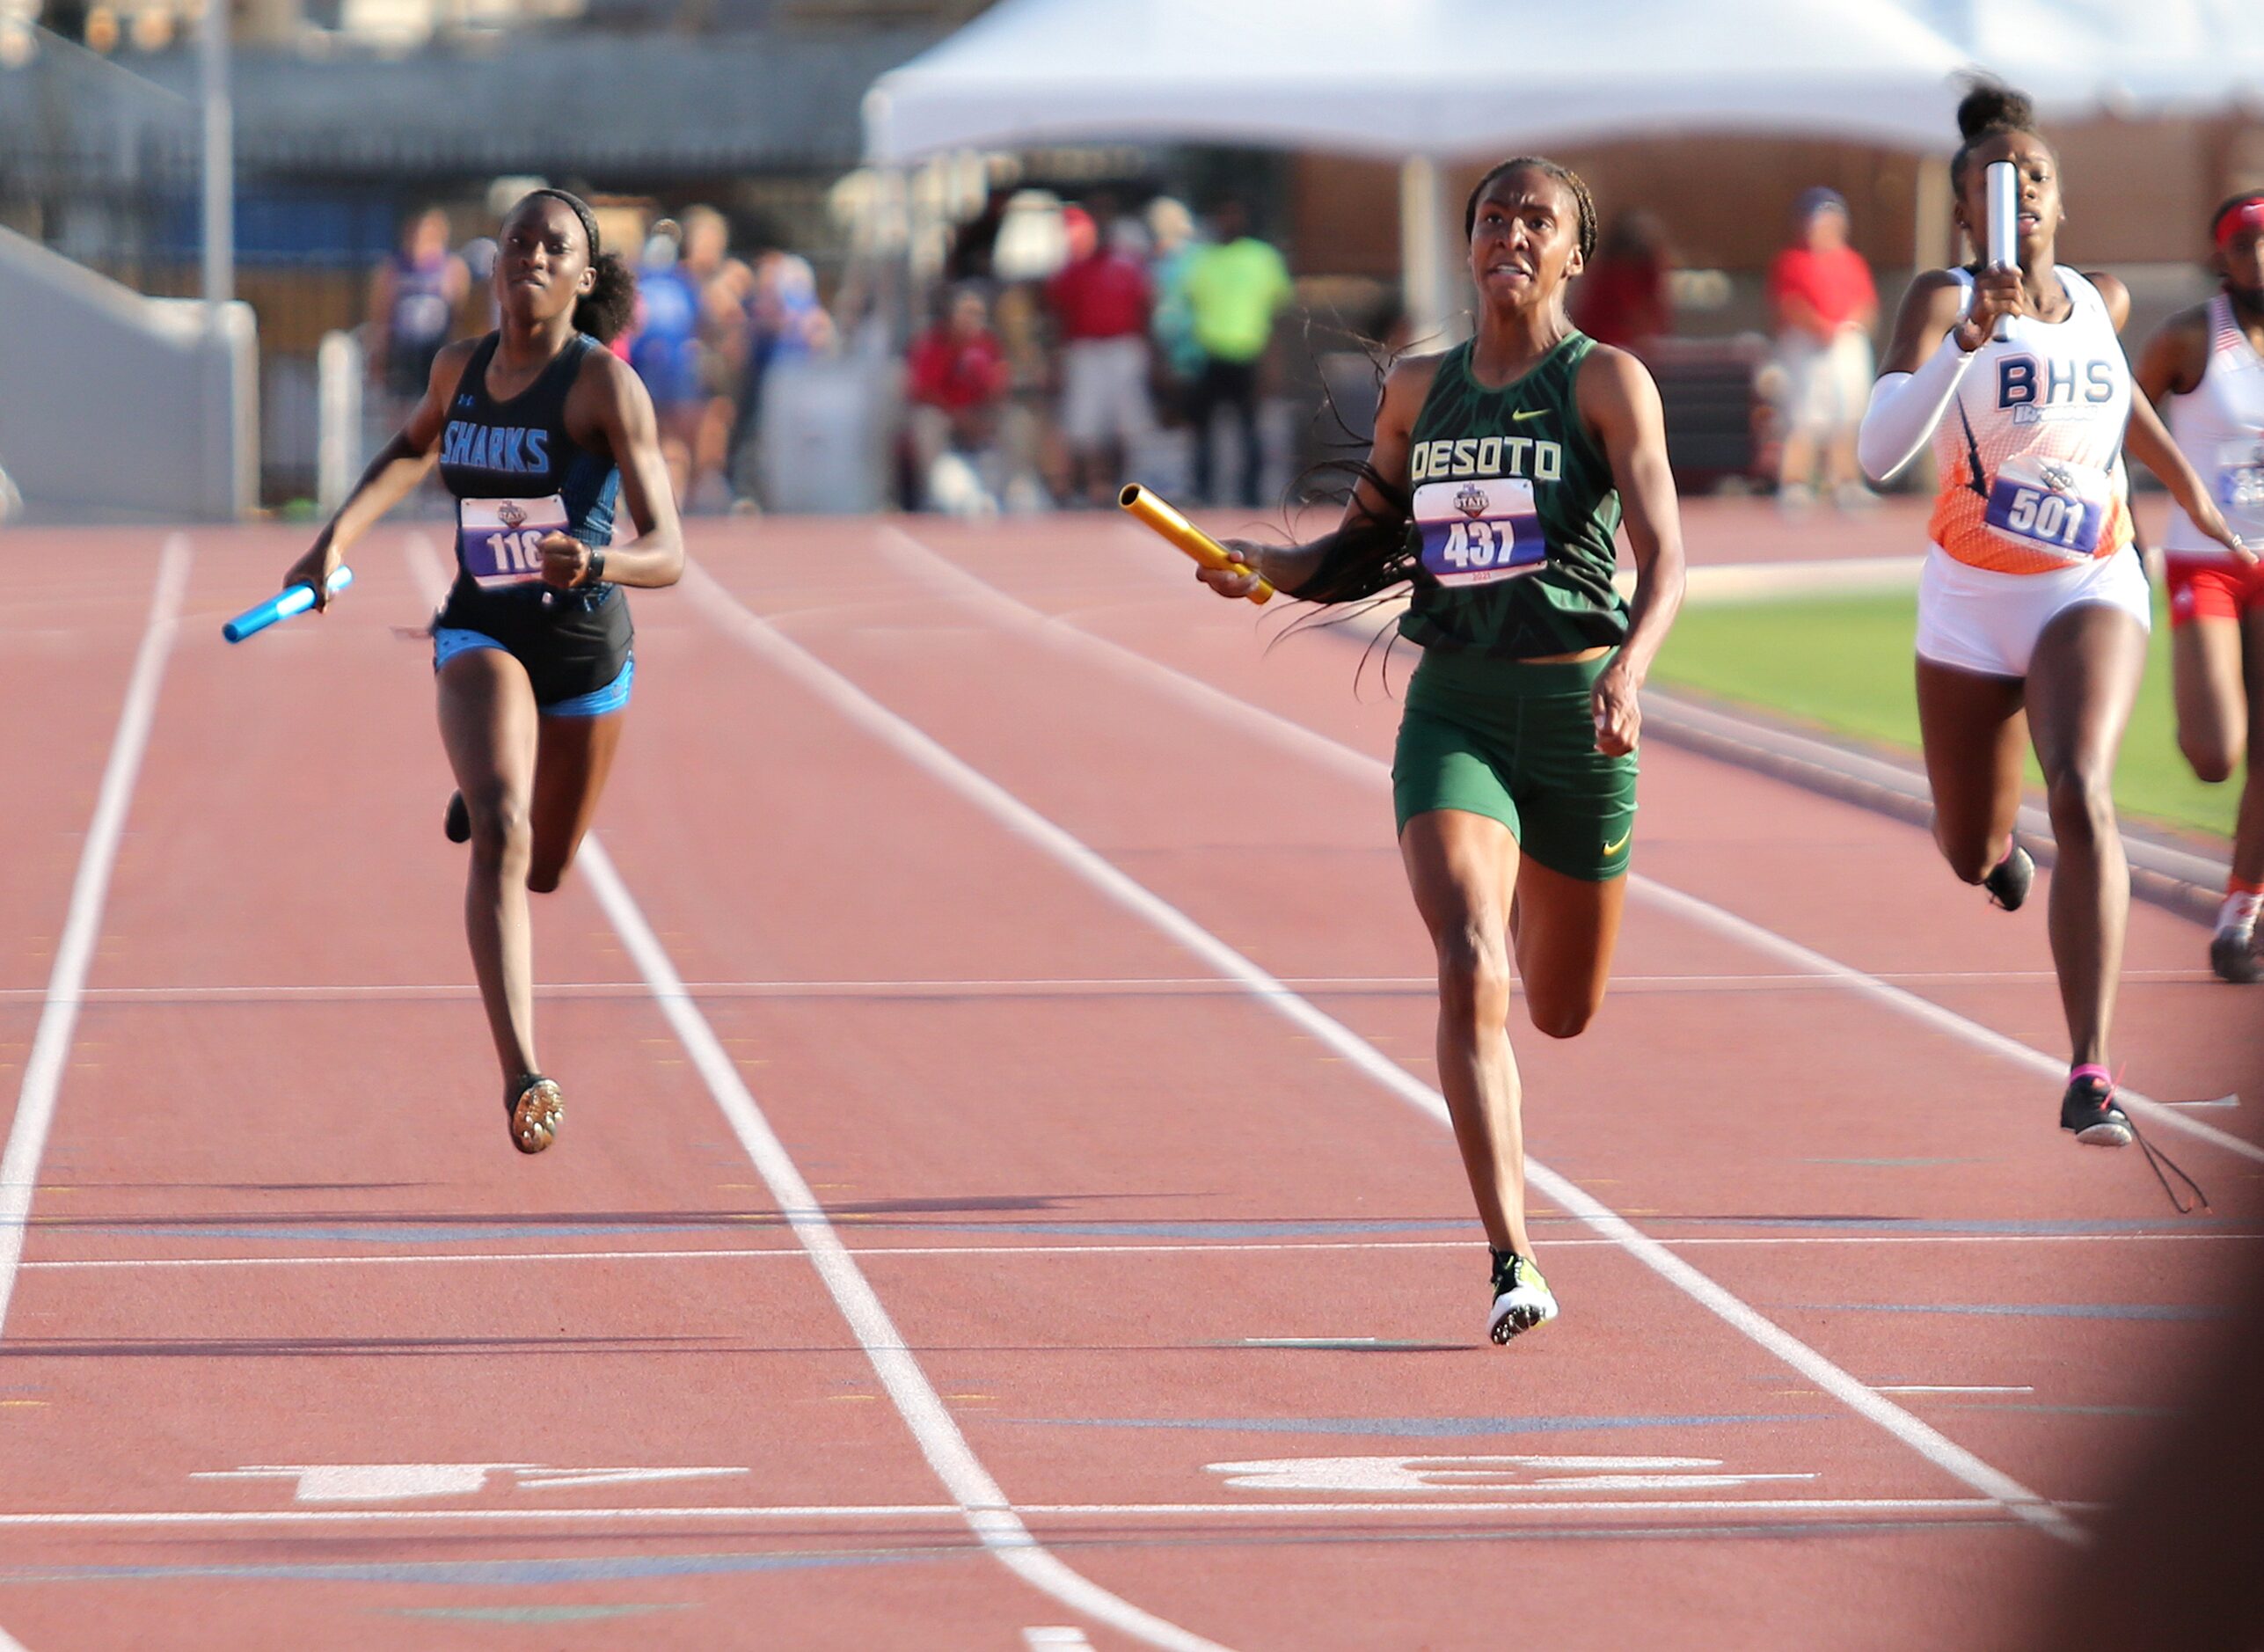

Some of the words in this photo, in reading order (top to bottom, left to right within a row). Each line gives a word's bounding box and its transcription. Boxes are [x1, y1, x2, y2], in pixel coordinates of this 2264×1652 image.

[1996, 353, 2113, 411] BHS
[440, 420, 549, 473] SHARKS
[1412, 436, 1561, 481] DESOTO
[1454, 495, 1489, 508] STATE
[2009, 487, 2085, 545] 501
[1443, 520, 1515, 568] 437
